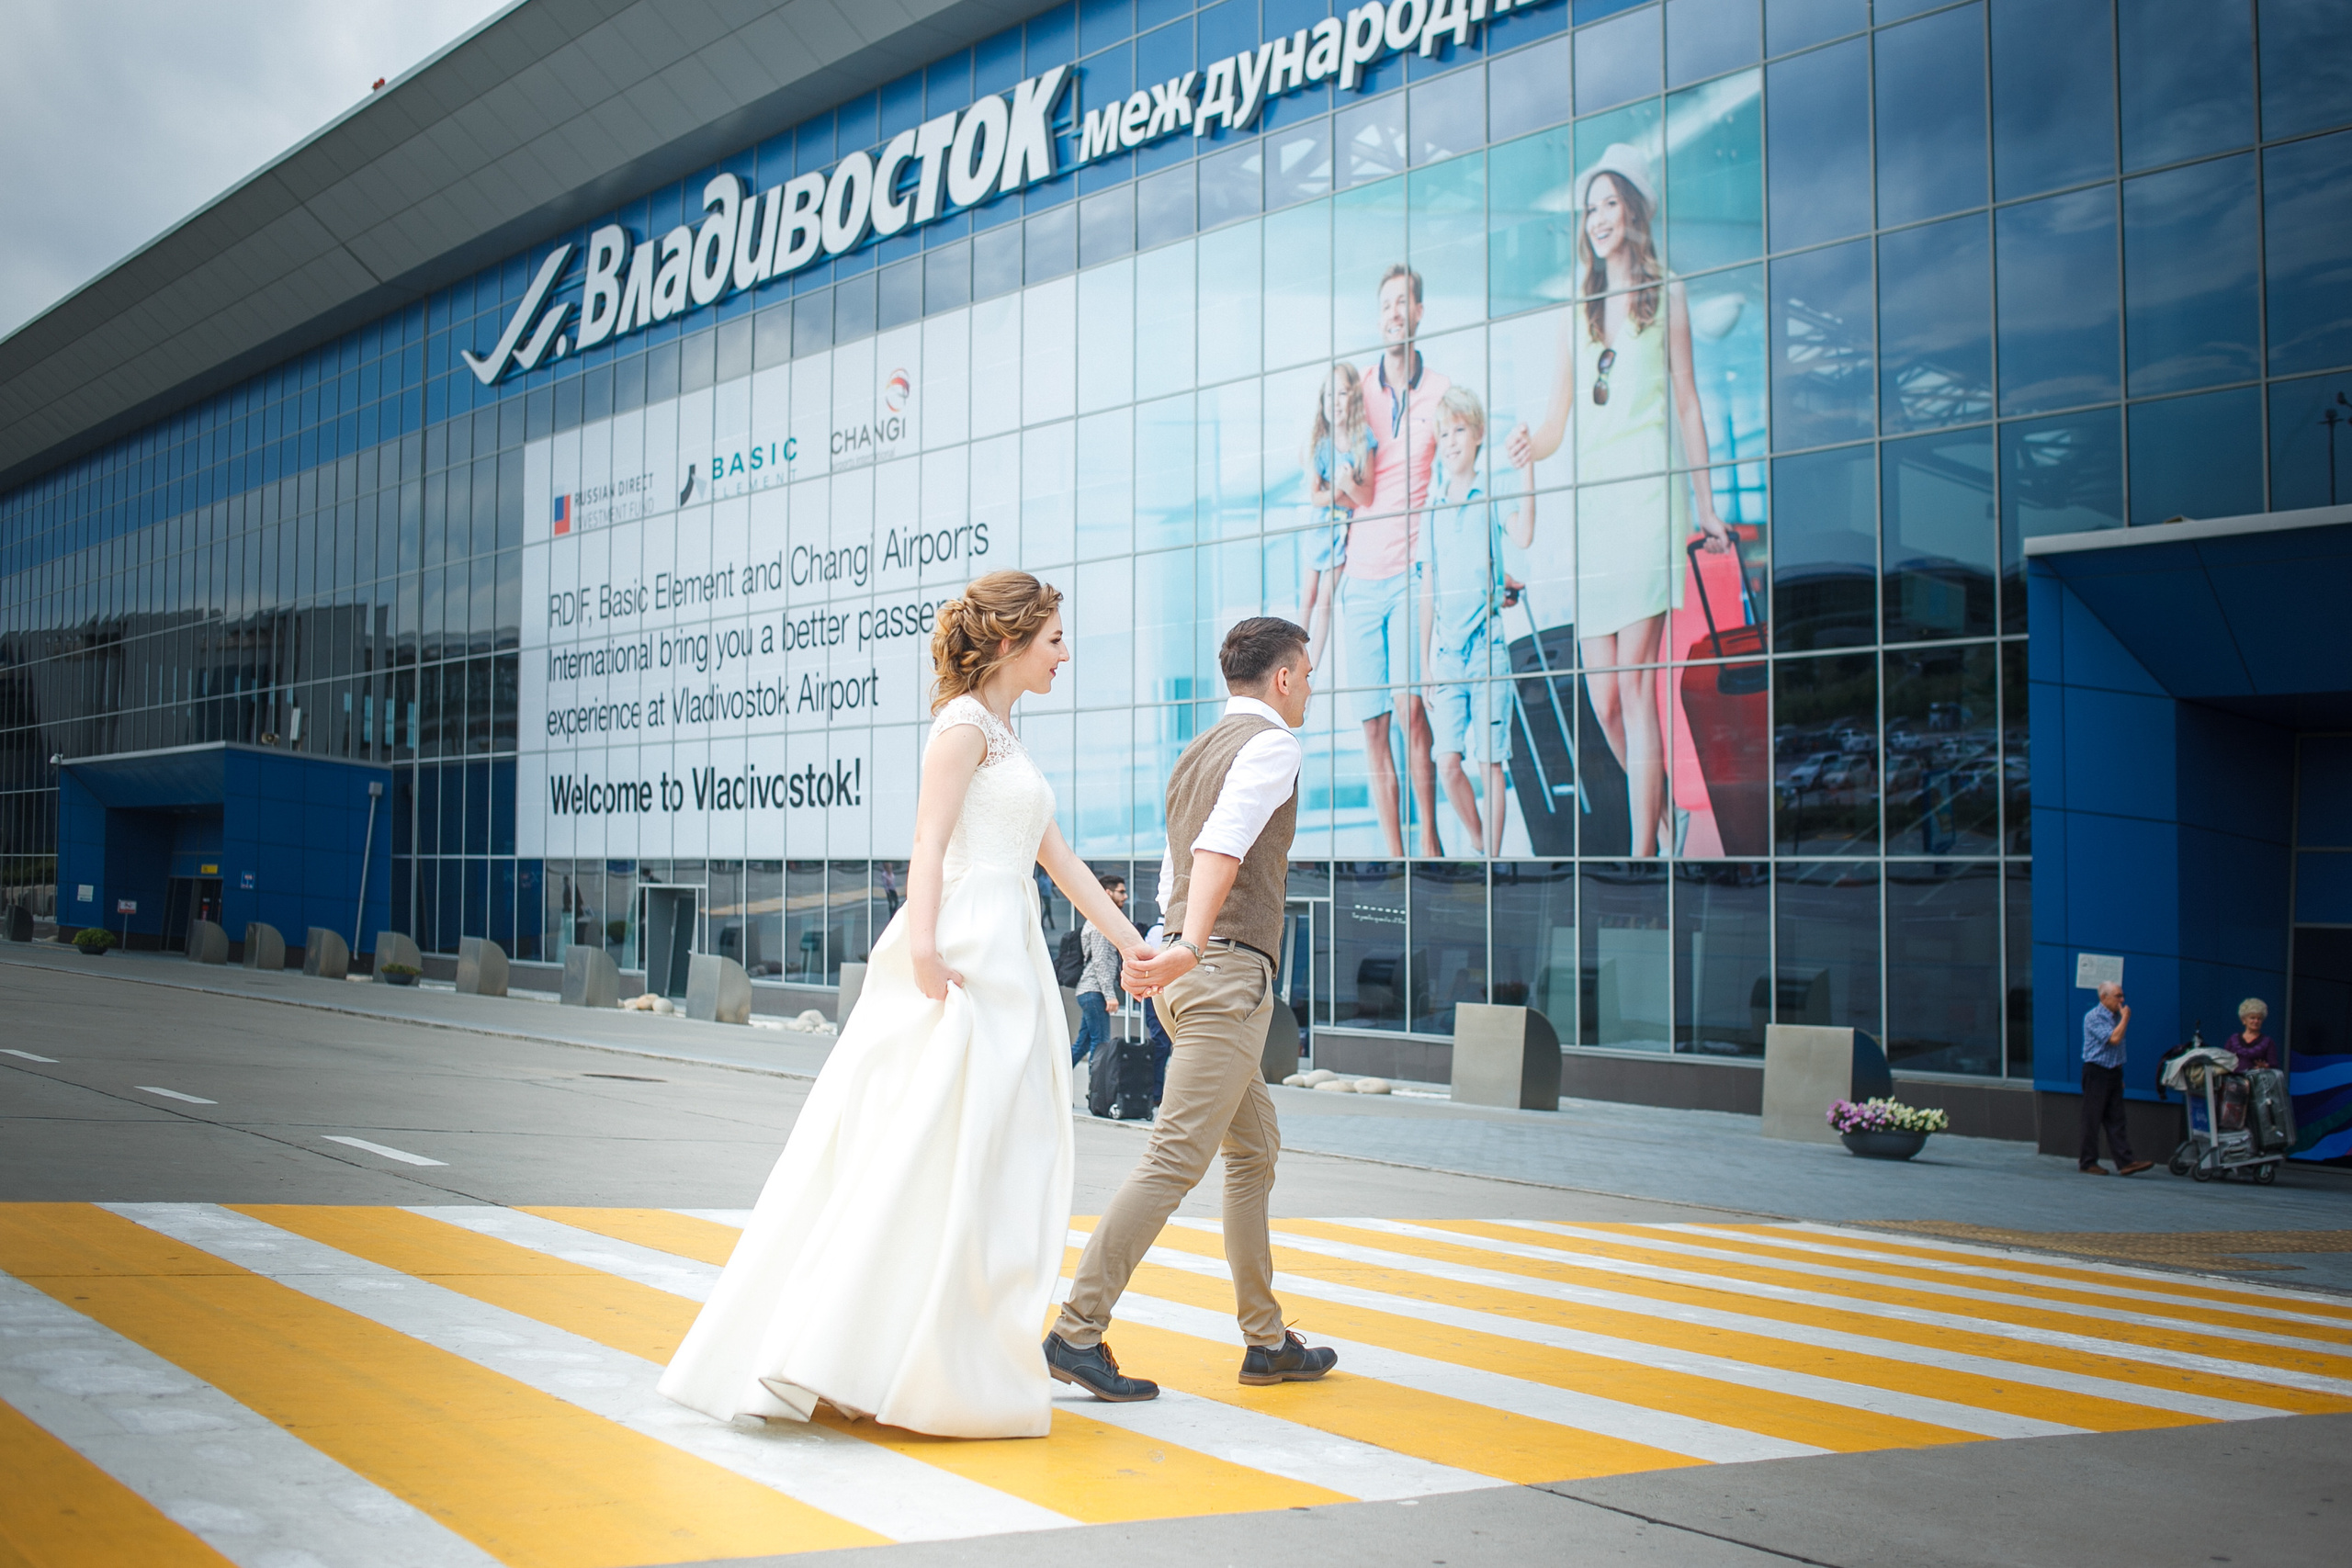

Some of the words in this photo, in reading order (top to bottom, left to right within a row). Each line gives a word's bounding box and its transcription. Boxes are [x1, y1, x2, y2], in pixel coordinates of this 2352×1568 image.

[576, 64, 1072, 350] Владивосток
[1079, 0, 1536, 163] международ
[712, 437, 797, 480] BASIC
[831, 416, 906, 455] CHANGI
[574, 483, 615, 508] RUSSIAN
[617, 472, 654, 497] DIRECT
[629, 497, 654, 518] FUND
[550, 587, 593, 628] RDIF,
[599, 578, 648, 620] Basic
[655, 562, 734, 611] Element
[742, 549, 782, 595] and
[790, 533, 874, 587] Changi
[883, 523, 989, 577] Airports
[548, 633, 652, 682] International
[661, 628, 707, 672] bring
[716, 627, 753, 671] you
[761, 625, 774, 654] a
[783, 609, 850, 651] better
[858, 598, 961, 652] passe
[547, 696, 642, 743] experience
[648, 692, 665, 728] at
[673, 676, 789, 725] Vladivostok
[797, 668, 878, 721] Airport
[550, 773, 653, 815] Welcome
[661, 772, 684, 812] to
[692, 758, 861, 810] Vladivostok!
